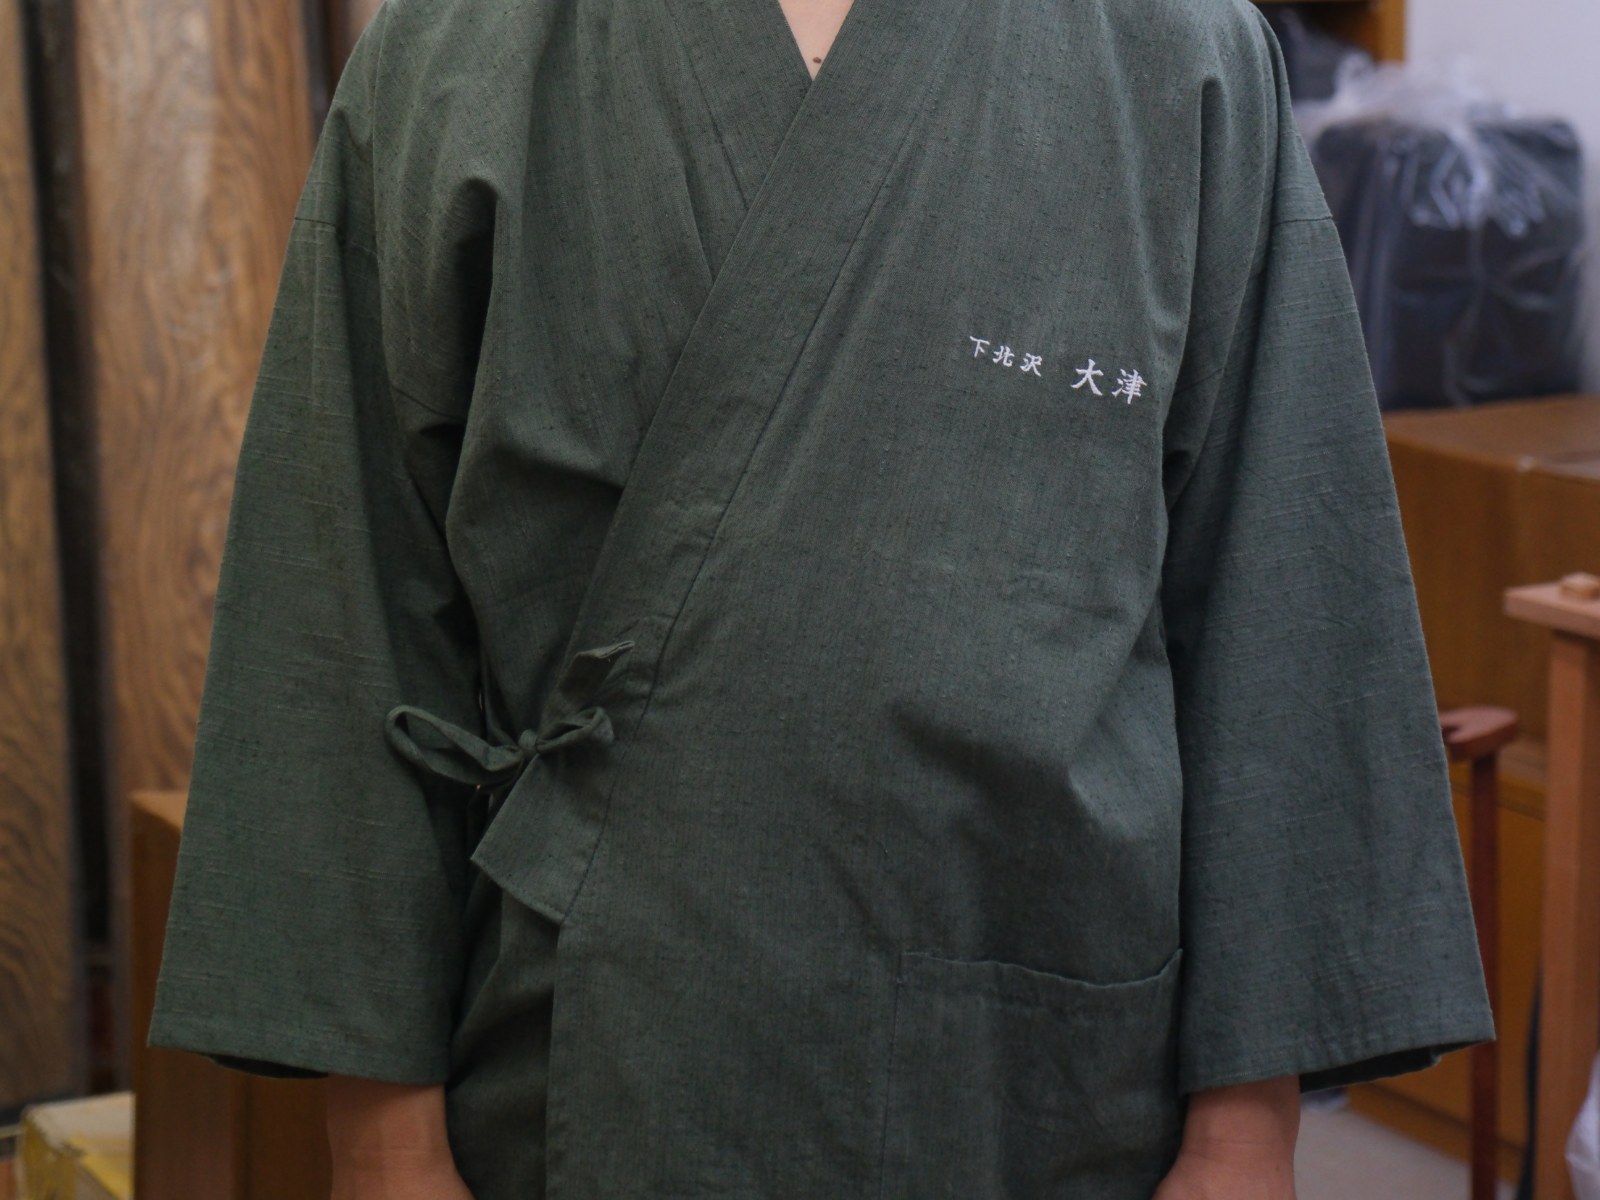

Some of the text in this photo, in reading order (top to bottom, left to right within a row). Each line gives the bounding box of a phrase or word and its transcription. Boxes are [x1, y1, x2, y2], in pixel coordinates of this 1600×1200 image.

[969, 335, 1148, 405] 下北沢 大津
